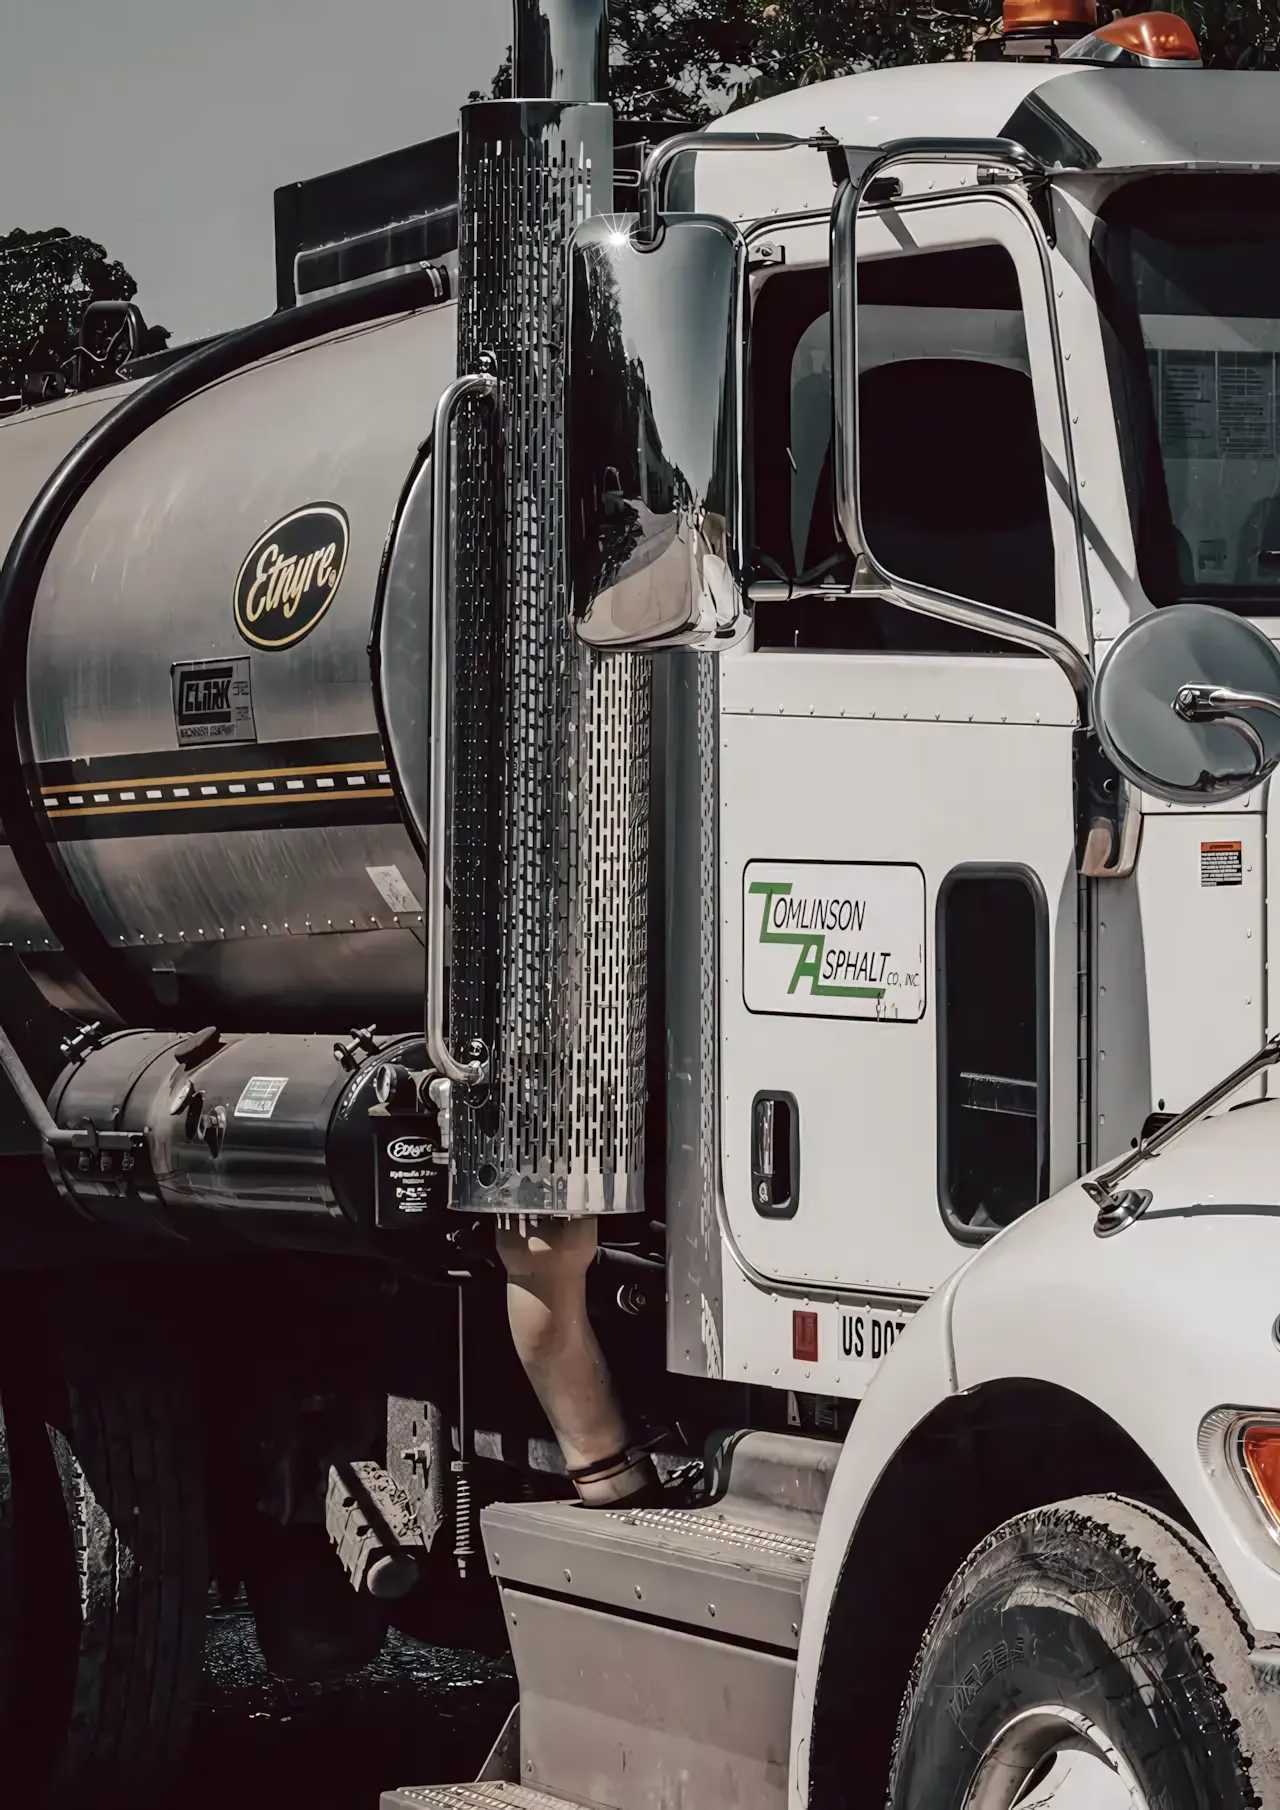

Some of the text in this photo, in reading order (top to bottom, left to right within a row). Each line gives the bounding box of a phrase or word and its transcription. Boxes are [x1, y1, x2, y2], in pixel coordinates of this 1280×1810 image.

[246, 543, 337, 622] Etnyre
[184, 679, 232, 712] CLARK
[749, 882, 866, 936] TOMLINSON
[787, 941, 891, 994] ASPHALT
[843, 1315, 906, 1360] US DO
